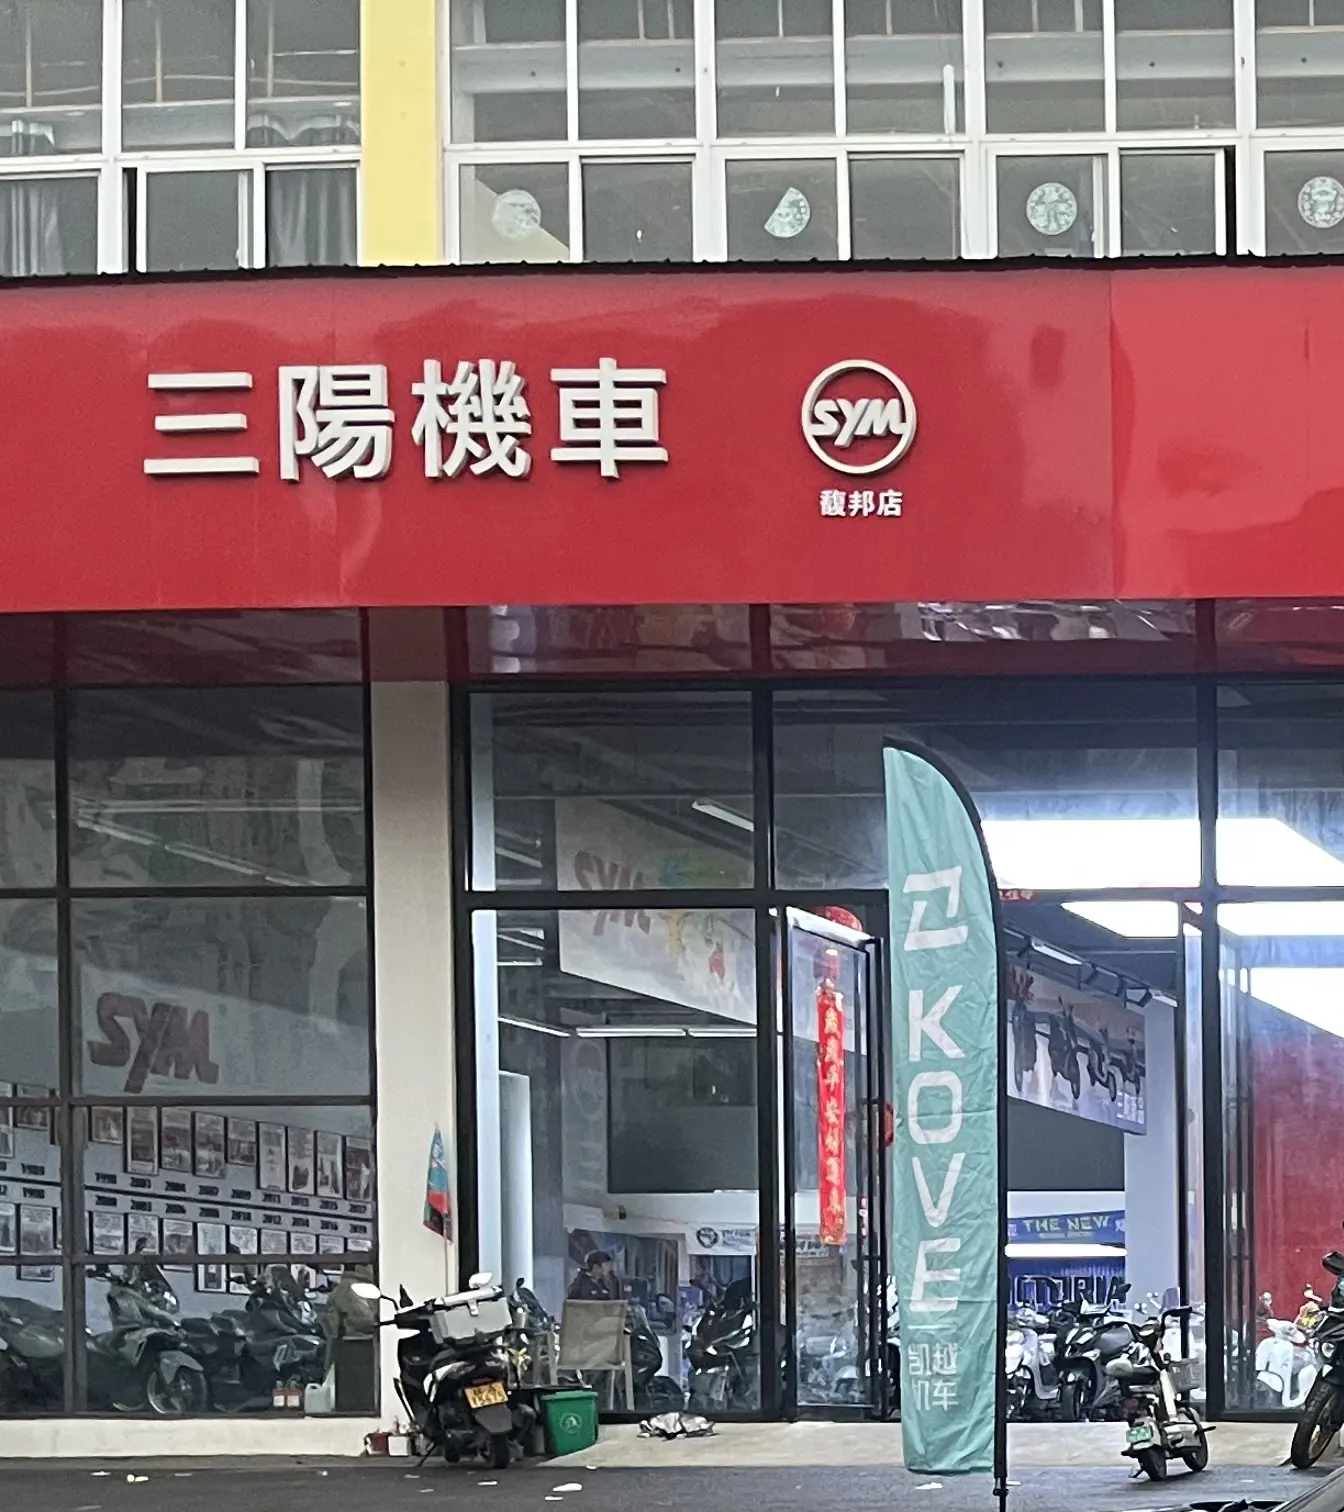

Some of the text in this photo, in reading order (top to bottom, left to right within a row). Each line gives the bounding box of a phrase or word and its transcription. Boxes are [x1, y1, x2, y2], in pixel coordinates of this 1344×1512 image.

[143, 357, 669, 481] 三陽機車
[812, 396, 908, 449] SYM
[819, 489, 903, 517] 馥邦店
[90, 991, 220, 1094] SYM
[908, 984, 966, 1313] KOVE
[1022, 1218, 1061, 1233] THE
[1066, 1215, 1110, 1231] NEW
[907, 1342, 960, 1378] 凯越
